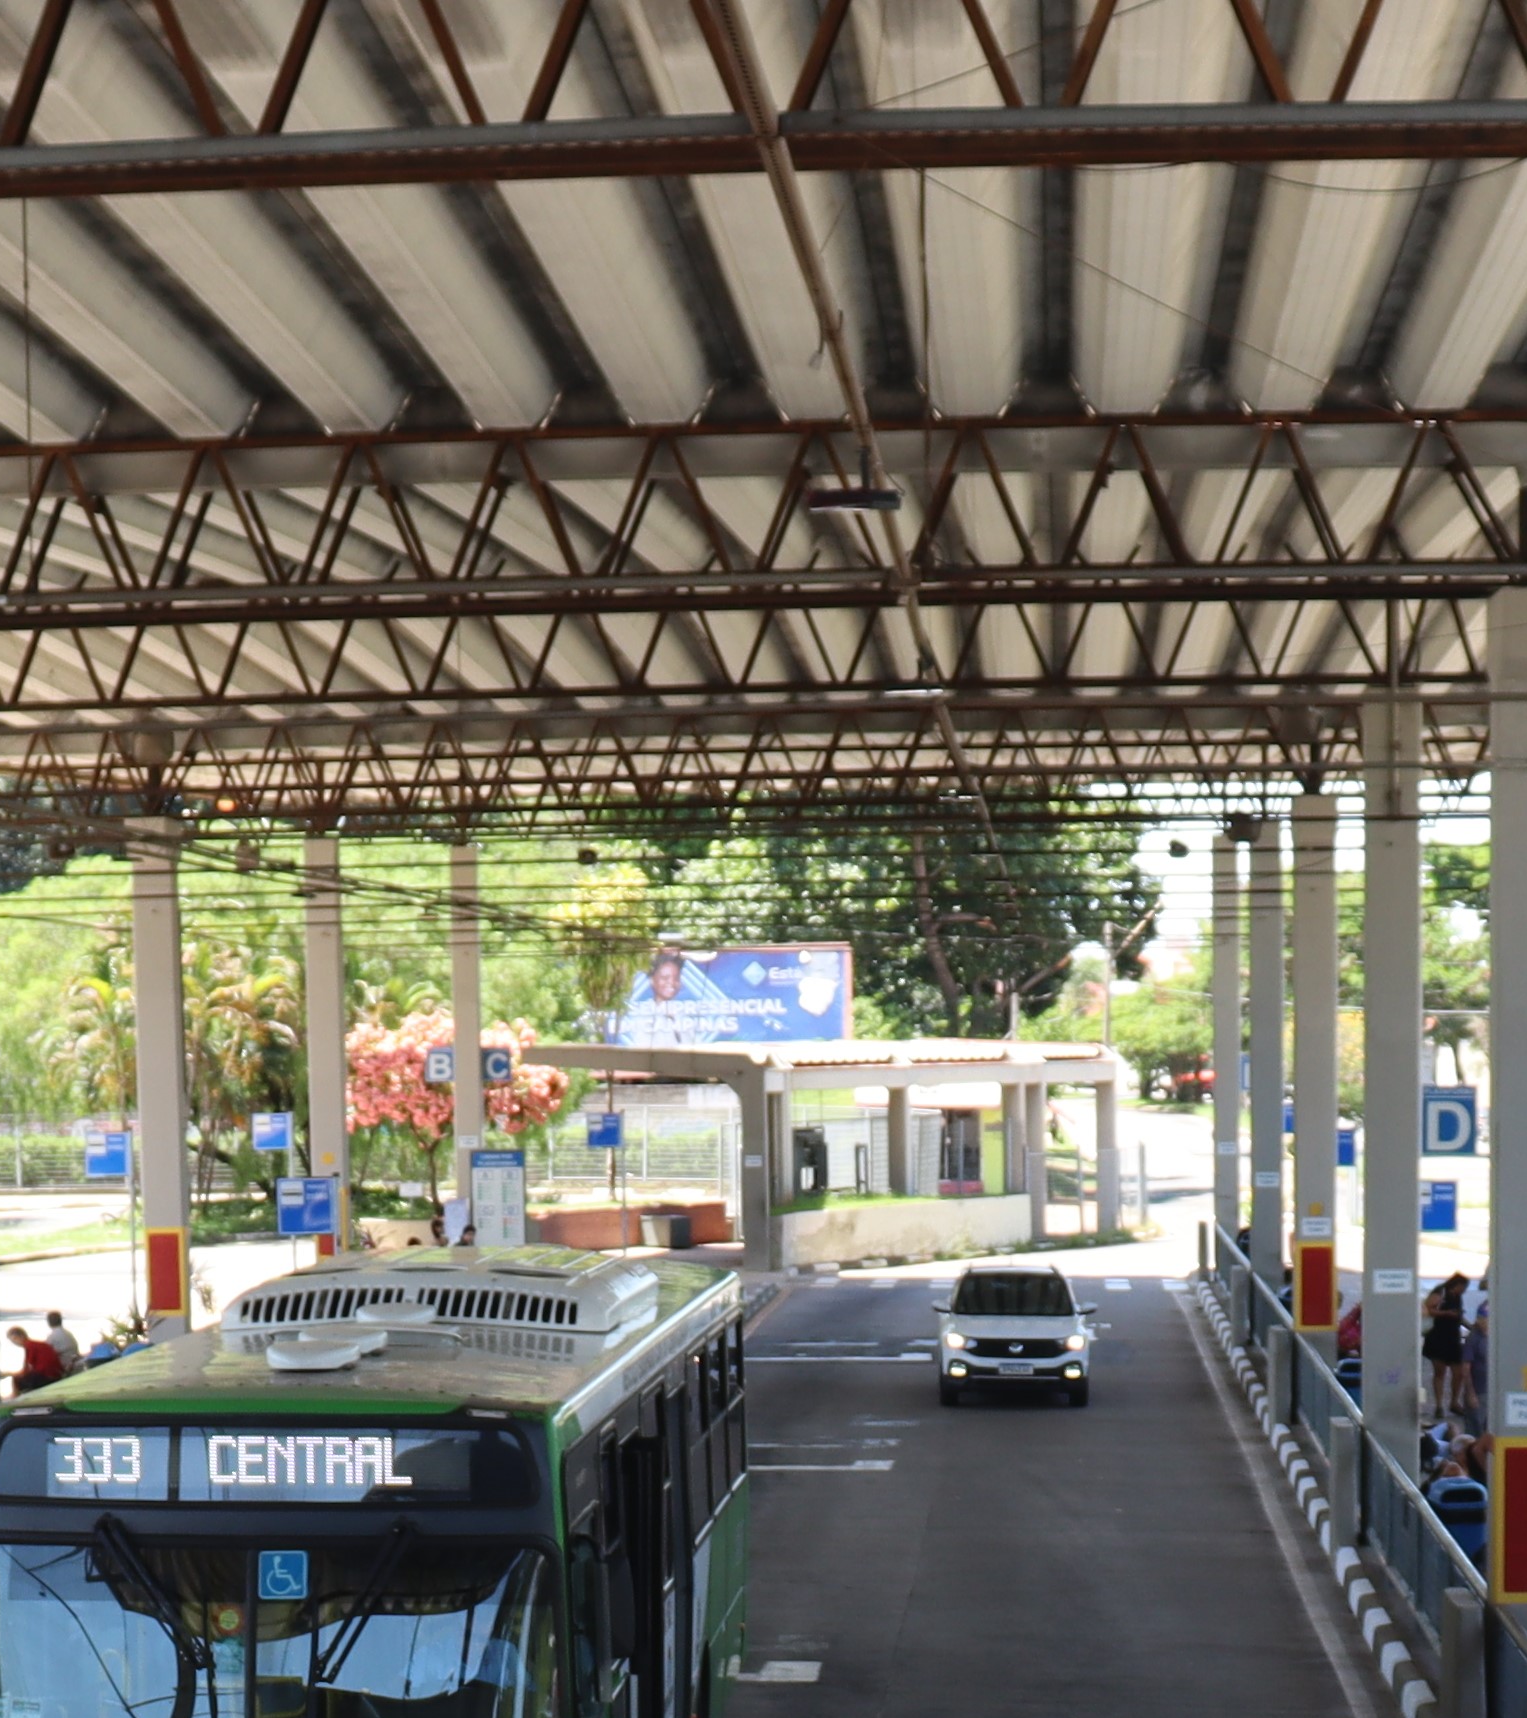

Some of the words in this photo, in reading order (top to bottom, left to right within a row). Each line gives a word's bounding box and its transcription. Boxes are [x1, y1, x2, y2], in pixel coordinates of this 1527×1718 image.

[627, 998, 787, 1015] SEMIPRESENCIAL
[428, 1053, 452, 1079] B
[486, 1053, 508, 1079] C
[1427, 1101, 1472, 1151] D
[53, 1434, 141, 1485] 333
[208, 1434, 413, 1486] CENTRAL
